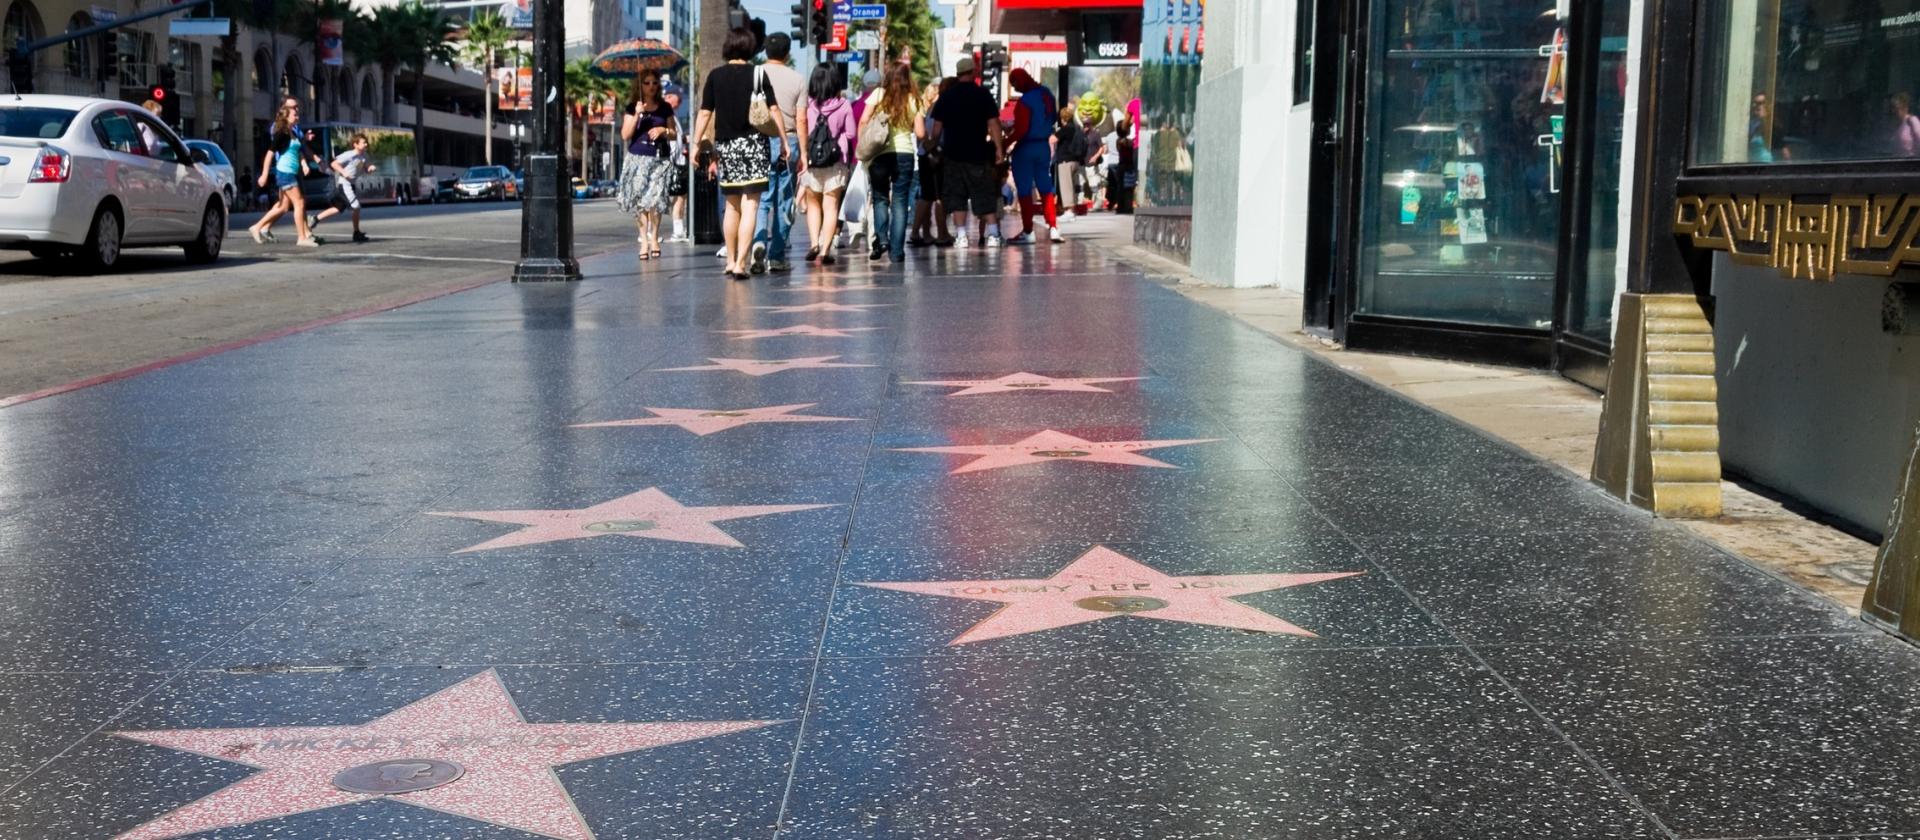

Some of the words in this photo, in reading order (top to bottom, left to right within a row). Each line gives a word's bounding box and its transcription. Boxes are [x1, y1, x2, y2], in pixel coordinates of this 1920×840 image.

[852, 8, 880, 17] Orange
[1098, 42, 1128, 57] 6933
[944, 584, 1072, 596] TOMMY
[1088, 582, 1153, 592] LEE
